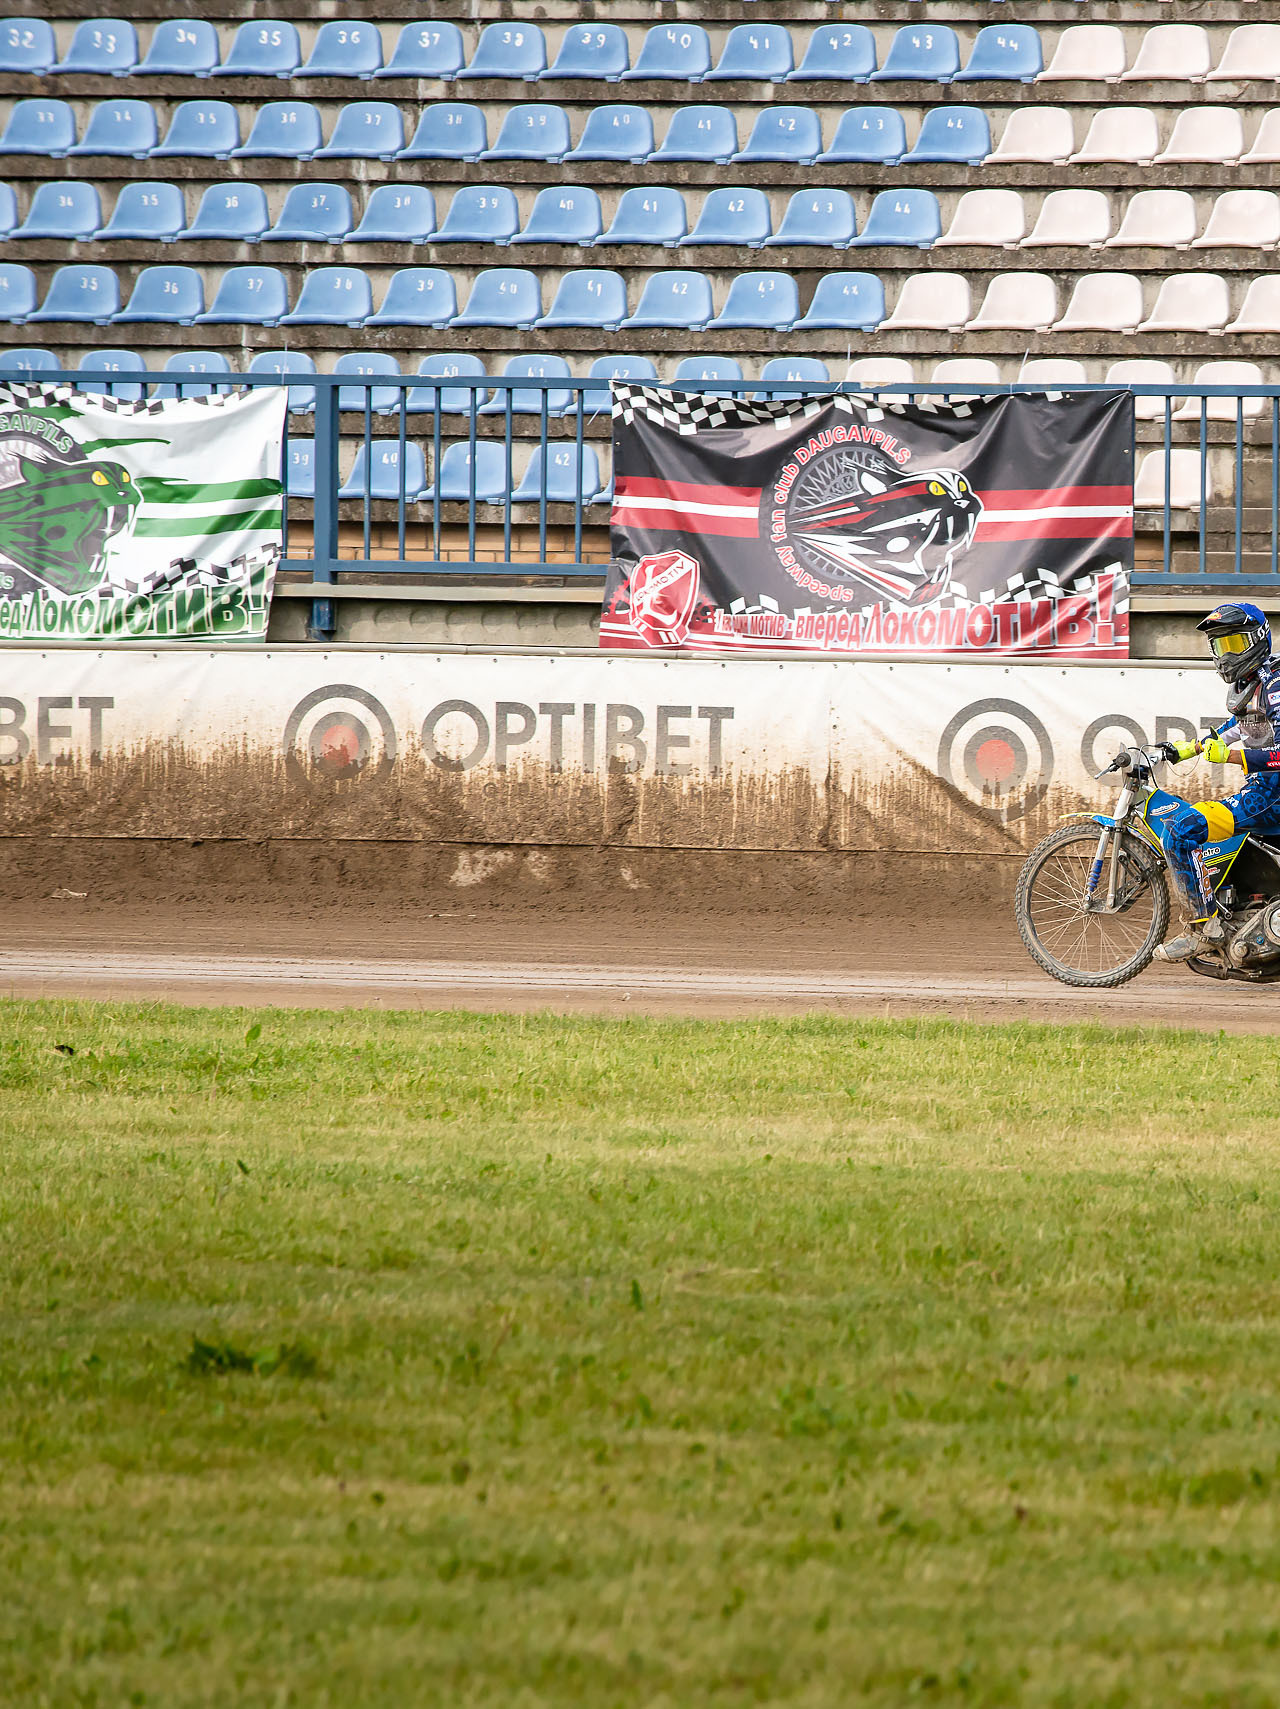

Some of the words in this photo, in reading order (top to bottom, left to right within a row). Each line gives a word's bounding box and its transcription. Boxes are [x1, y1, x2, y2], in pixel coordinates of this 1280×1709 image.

[9, 29, 34, 48] 32
[94, 32, 116, 53] 33
[176, 29, 196, 44] 34
[259, 31, 281, 46] 35
[338, 31, 360, 43] 36
[418, 32, 440, 47] 37
[502, 32, 523, 46] 38
[581, 33, 606, 47] 39
[665, 29, 692, 49] 40
[748, 36, 770, 49] 41
[829, 34, 852, 49] 42
[911, 35, 933, 49] 43
[996, 36, 1019, 50] 44
[792, 424, 913, 466] DAUGAVPILS
[293, 452, 310, 466] 39
[382, 452, 400, 468] 40
[555, 452, 570, 466] 42
[773, 463, 800, 506] club
[770, 509, 787, 543] fan
[775, 546, 855, 602] speedway
[795, 613, 862, 649] вперед
[421, 699, 735, 777] OPTIBET
[1203, 847, 1221, 858] etro
